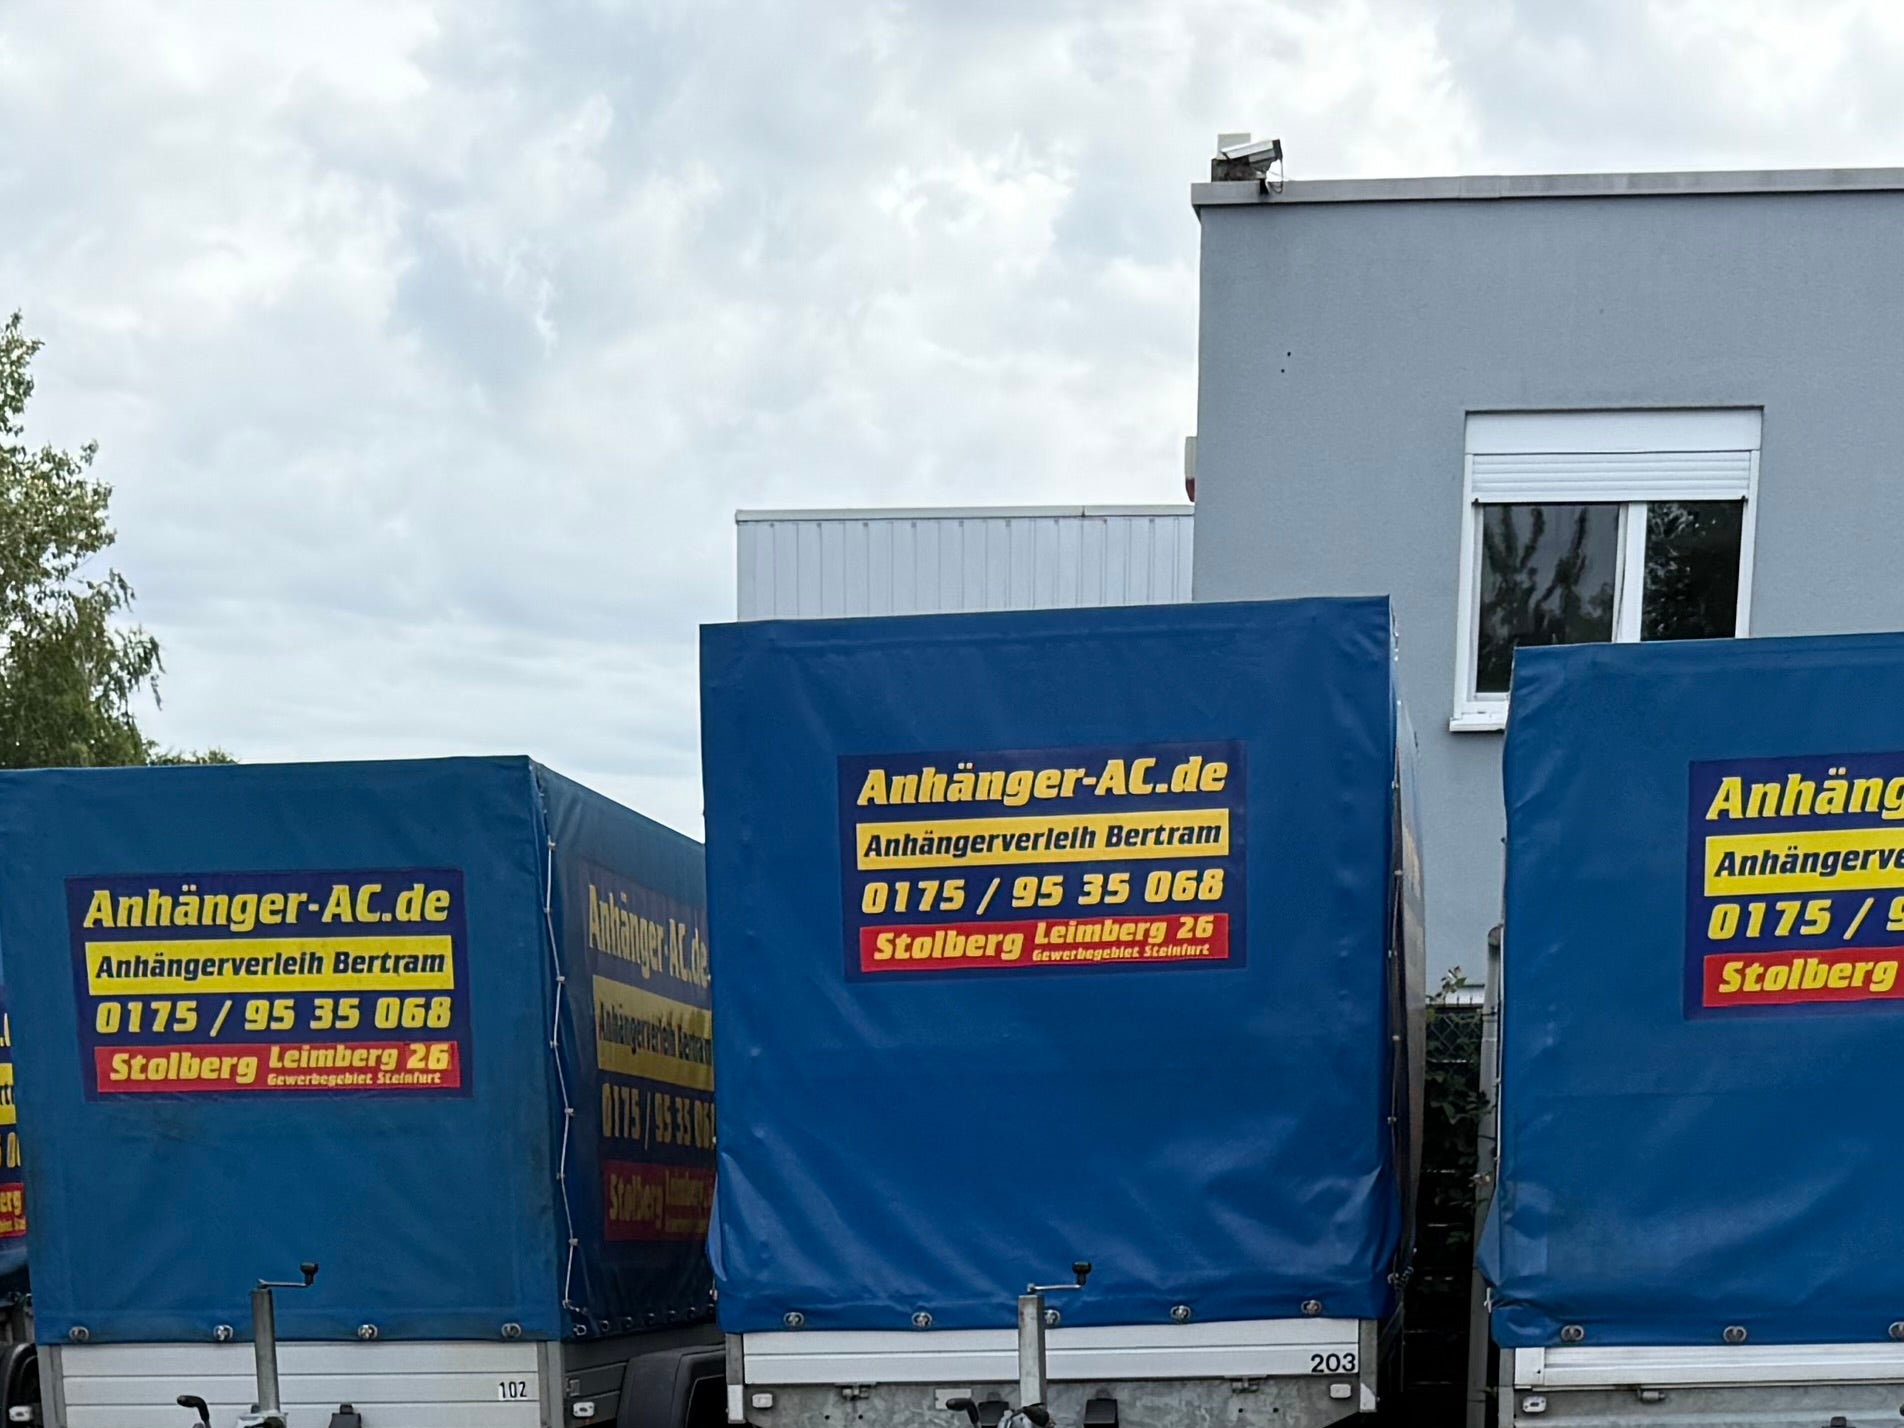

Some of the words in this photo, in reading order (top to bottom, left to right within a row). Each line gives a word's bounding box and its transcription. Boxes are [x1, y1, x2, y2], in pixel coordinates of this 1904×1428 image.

[856, 756, 1229, 807] Anhänger-AC.de
[863, 826, 1096, 858] Anhängerverleih
[1106, 823, 1221, 848] Bertram
[83, 883, 450, 932] Anhänger-AC.de
[861, 879, 966, 914] 0175
[976, 878, 1000, 915] /
[1011, 875, 1064, 908] 95
[1078, 872, 1130, 906] 35
[1144, 868, 1225, 903] 068
[873, 931, 1024, 961] Stolberg
[1034, 918, 1168, 946] Leimberg
[1176, 915, 1215, 940] 26
[1707, 899, 1832, 940] 0175
[1843, 897, 1875, 940] /
[96, 951, 323, 980] Anhängerverleih
[332, 951, 445, 974] Bertram
[1718, 958, 1898, 994] Stolberg
[96, 1000, 198, 1034] 0175
[209, 1000, 232, 1037] /
[244, 998, 296, 1031] 95
[309, 998, 360, 1030] 35
[374, 996, 452, 1030] 068
[109, 1052, 258, 1084] Stolberg
[268, 1045, 397, 1070] Leimberg
[406, 1042, 450, 1070] 26
[1310, 1353, 1356, 1373] 203
[499, 1381, 527, 1398] 102
